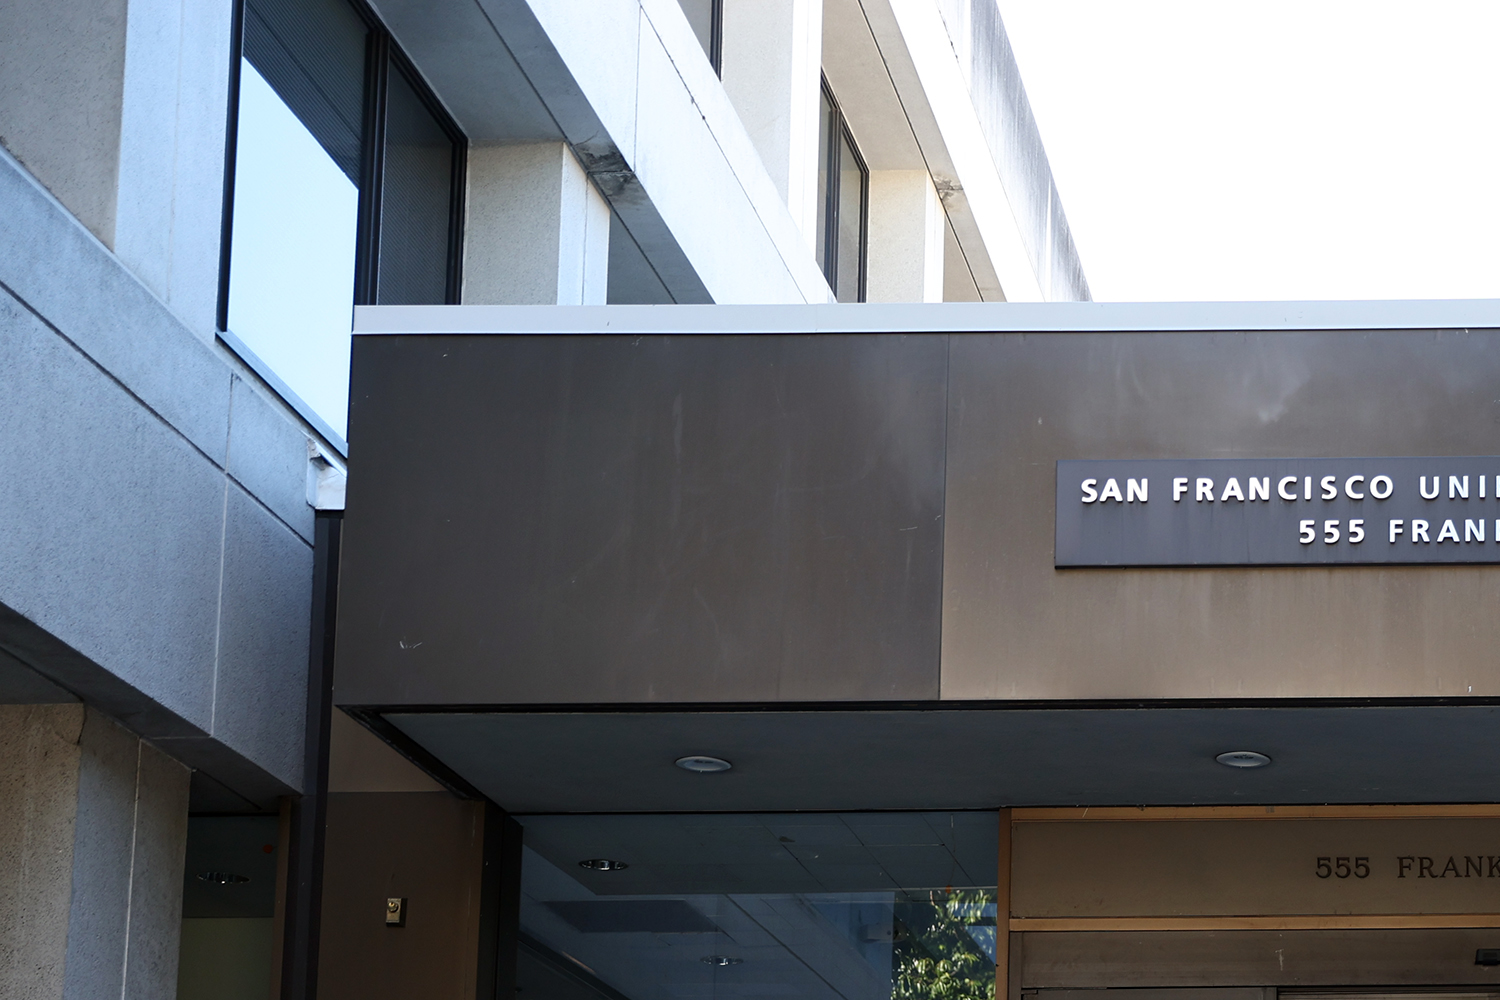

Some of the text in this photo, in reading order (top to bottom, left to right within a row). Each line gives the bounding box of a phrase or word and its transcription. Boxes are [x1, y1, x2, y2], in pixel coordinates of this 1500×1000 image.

[1080, 477, 1149, 503] SAN
[1172, 475, 1395, 502] FRANCISCO
[1299, 519, 1366, 545] 555
[1315, 856, 1371, 880] 555
